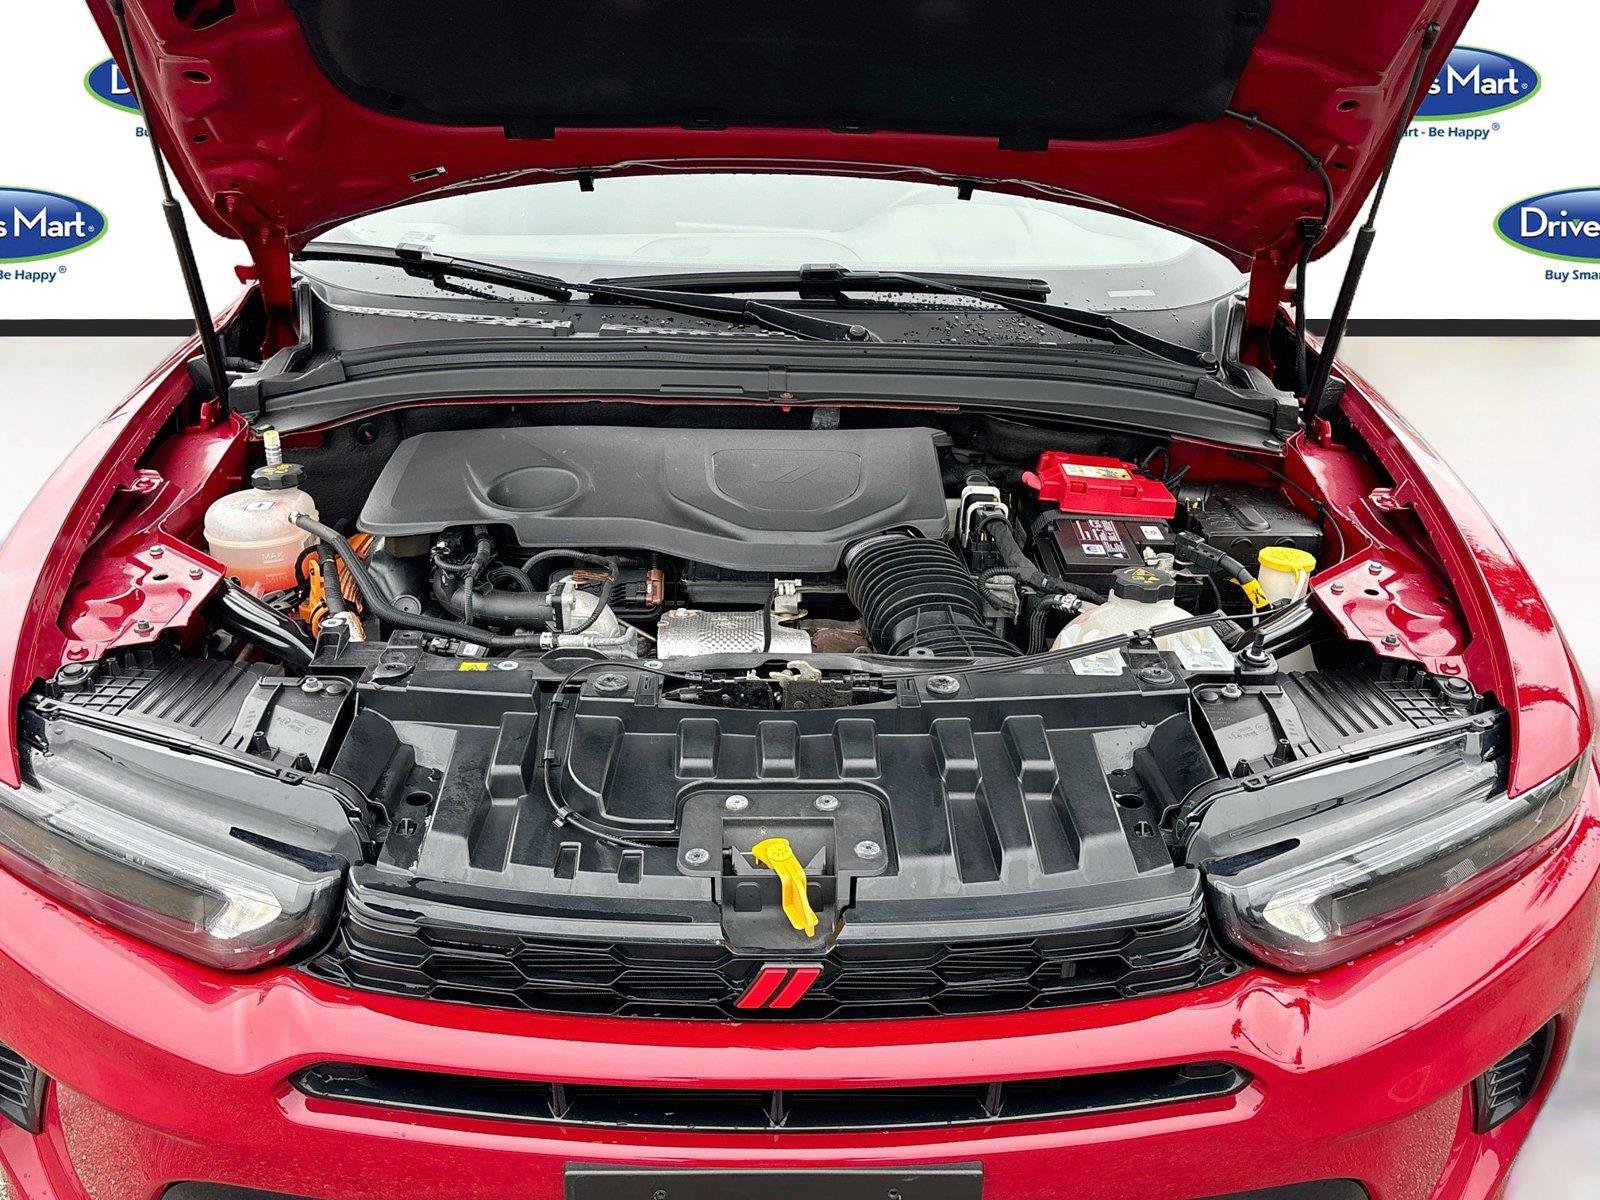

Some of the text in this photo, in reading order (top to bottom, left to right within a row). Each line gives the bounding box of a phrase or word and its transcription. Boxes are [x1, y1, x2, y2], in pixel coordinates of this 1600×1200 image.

[1447, 63, 1520, 95] Mart
[135, 126, 150, 137] Bu
[1428, 126, 1446, 137] Be
[1448, 126, 1490, 140] Happy
[13, 206, 86, 238] Mart
[15, 269, 57, 283] Happy
[1545, 269, 1600, 283] Buy Sma
